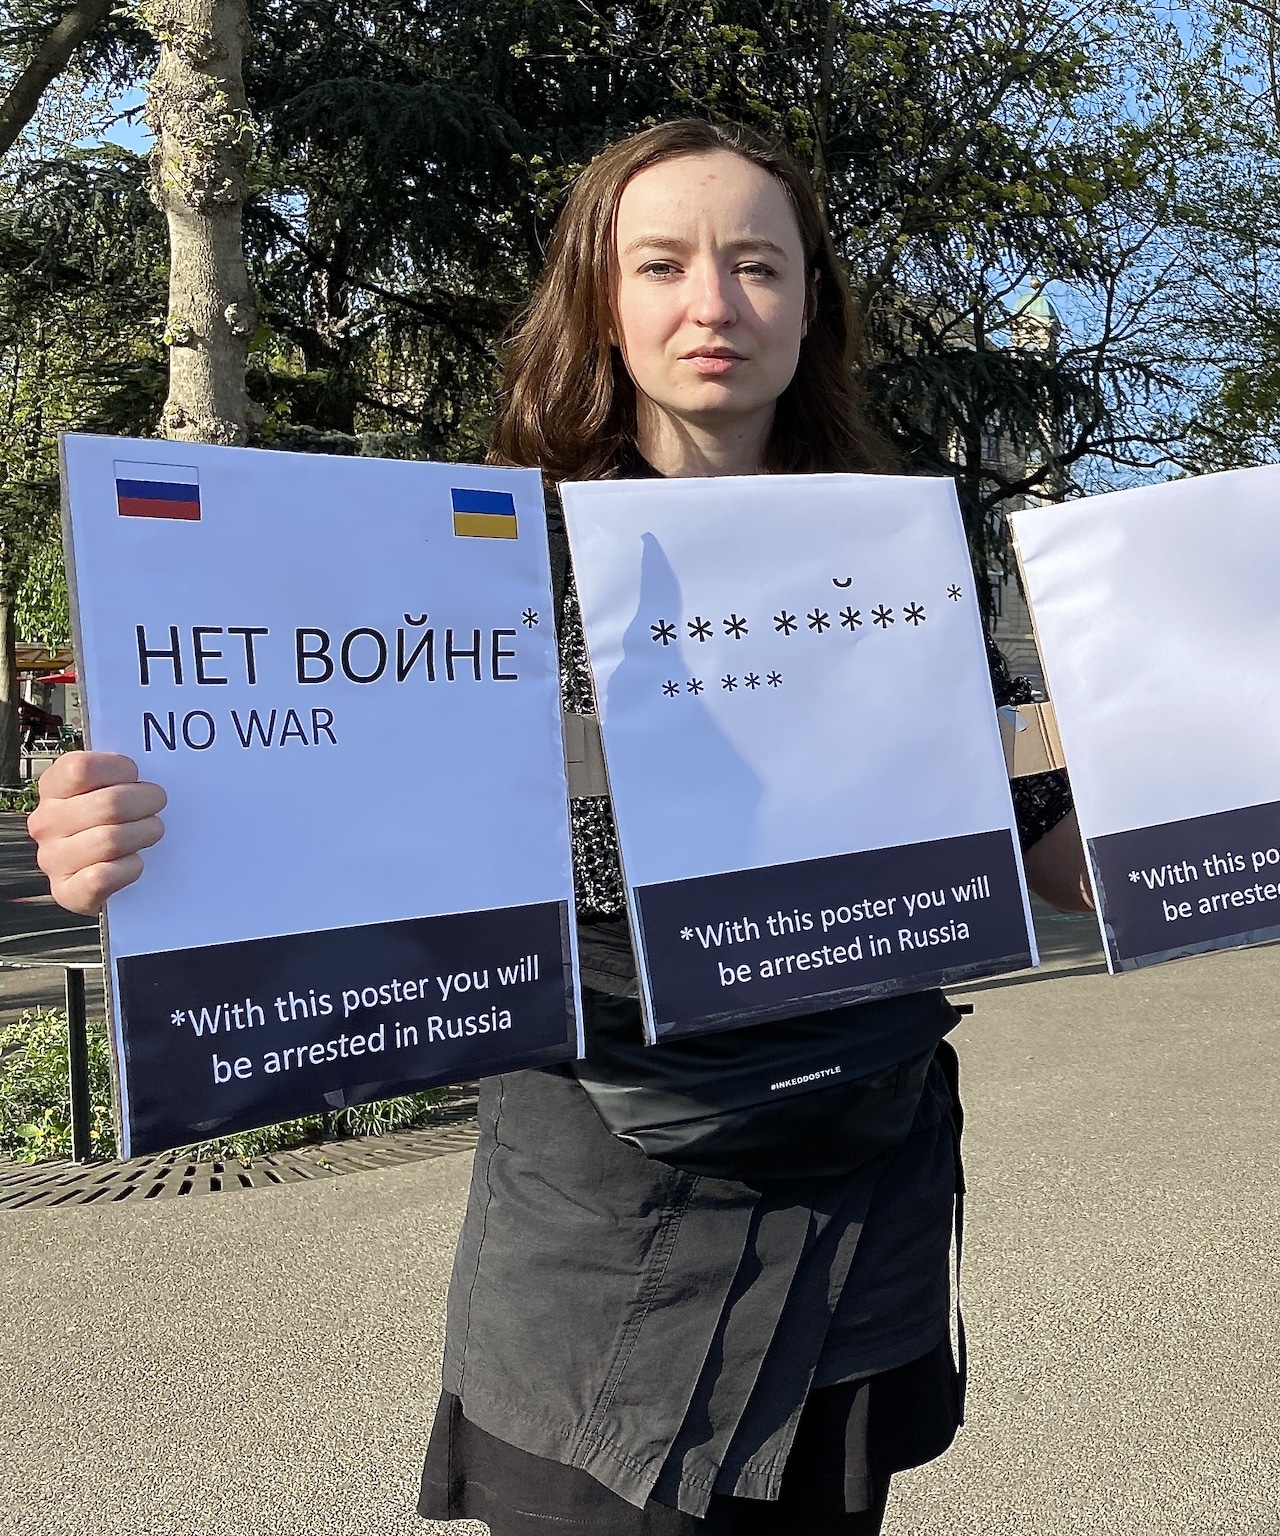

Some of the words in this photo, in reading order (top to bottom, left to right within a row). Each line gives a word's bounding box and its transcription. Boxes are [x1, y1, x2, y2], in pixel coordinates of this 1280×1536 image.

[136, 624, 269, 686] НЕТ
[143, 708, 216, 752] NO
[231, 708, 337, 748] WAR
[1203, 852, 1246, 877] this
[766, 909, 814, 937] this
[820, 898, 897, 932] poster
[903, 889, 946, 917] you
[951, 874, 991, 902] will
[1162, 899, 1193, 922] be
[717, 957, 752, 987] be
[759, 936, 863, 978] arrested
[868, 934, 892, 957] in
[897, 920, 970, 952] Russia
[273, 989, 333, 1021] this
[342, 977, 429, 1017] poster
[436, 969, 489, 1001] you
[496, 954, 539, 985] will
[212, 1053, 253, 1084] be
[263, 1023, 385, 1077] arrested
[395, 1021, 418, 1049] in
[427, 1005, 512, 1043] Russia
